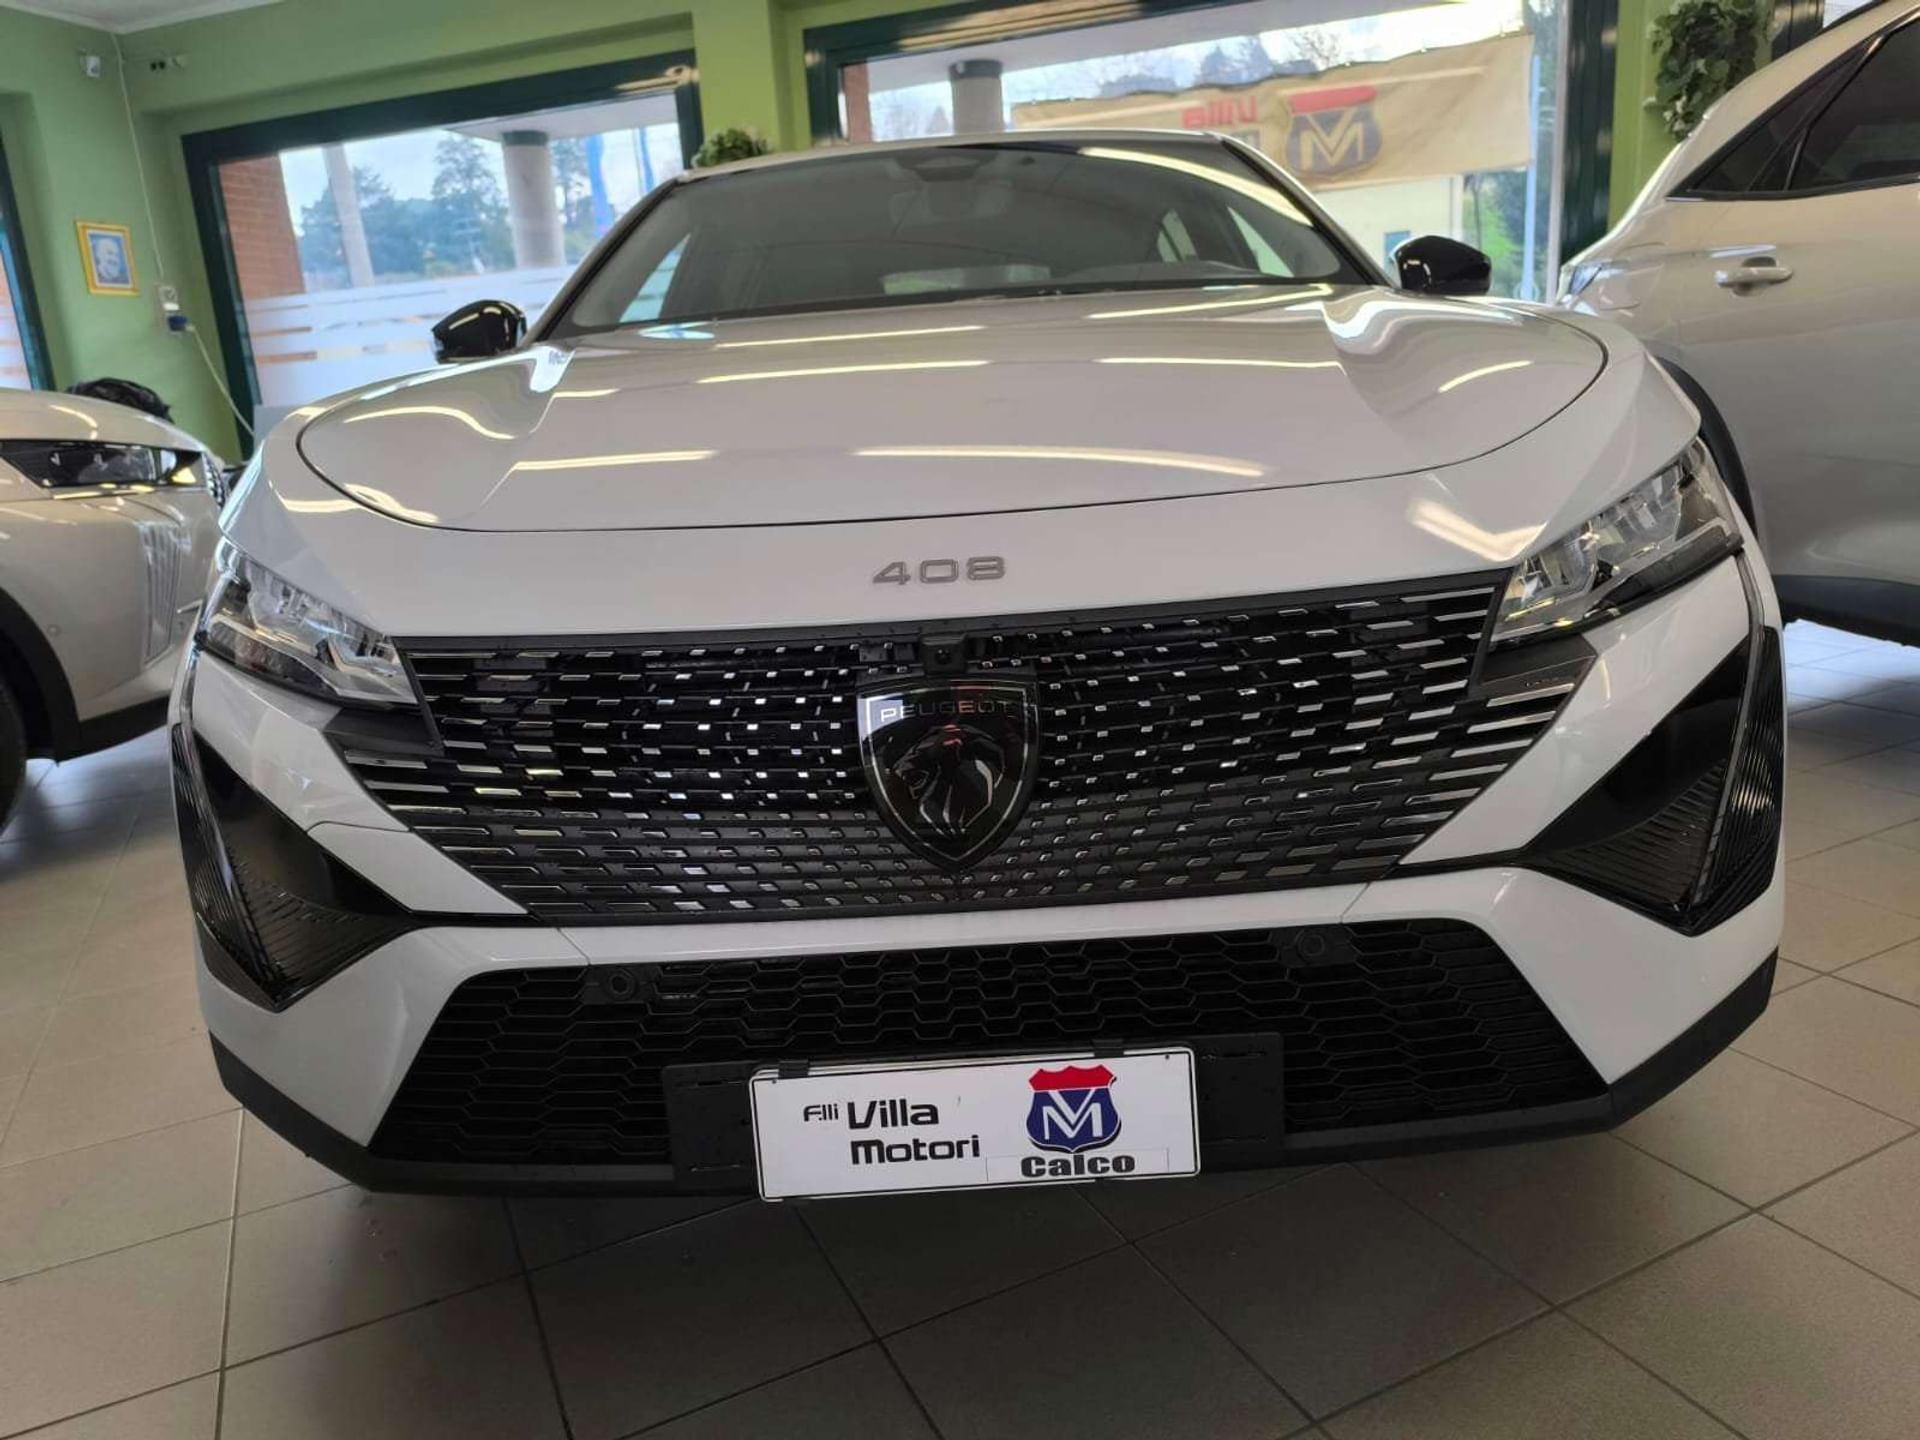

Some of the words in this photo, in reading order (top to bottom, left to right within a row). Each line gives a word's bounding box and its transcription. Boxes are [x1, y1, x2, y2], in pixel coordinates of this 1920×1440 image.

[872, 556, 1005, 585] 408
[880, 700, 1015, 722] PEUGEOT
[847, 1098, 939, 1129] Villa
[851, 1134, 980, 1165] Motori
[1021, 1154, 1135, 1178] Calco
